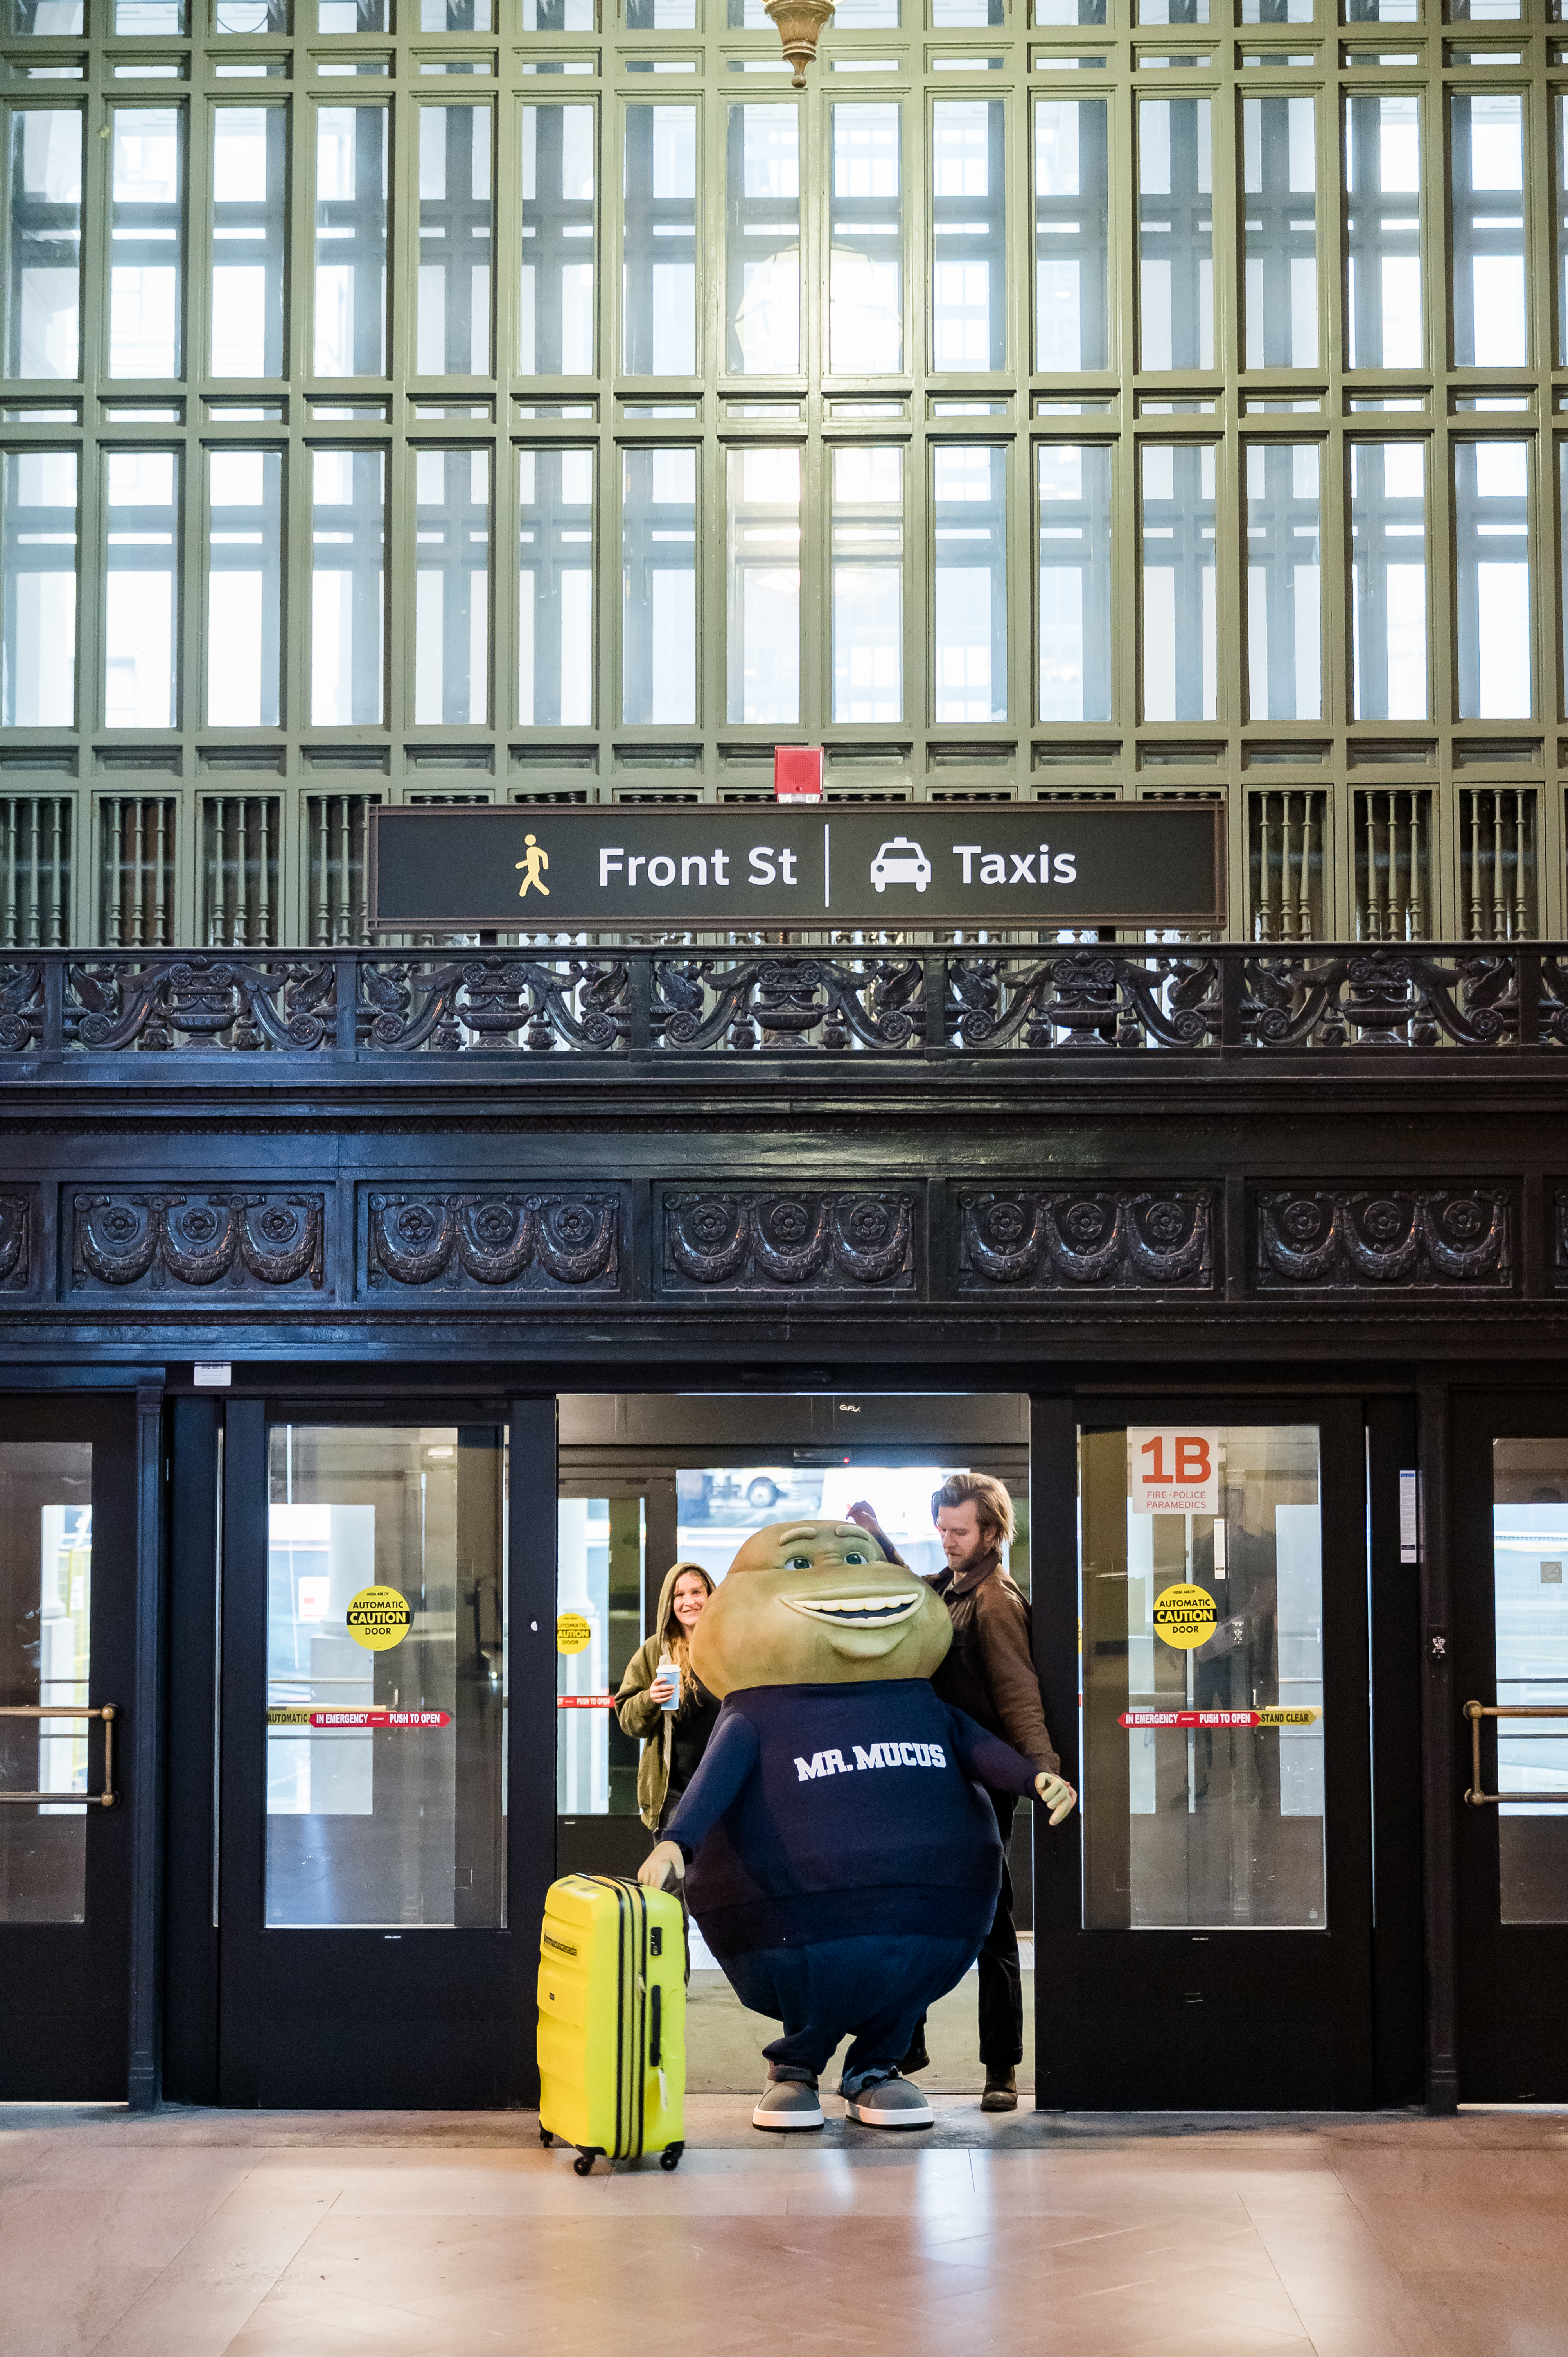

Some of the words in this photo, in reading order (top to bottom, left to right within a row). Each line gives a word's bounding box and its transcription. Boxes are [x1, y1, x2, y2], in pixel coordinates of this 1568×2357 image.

[600, 848, 729, 886] Front
[748, 846, 797, 885] St
[953, 844, 1076, 884] Taxis
[1141, 1436, 1211, 1483] 1B
[1159, 1599, 1210, 1607] AUTOMATIC
[350, 1612, 406, 1624] CAUTION
[1157, 1610, 1213, 1622] CAUTION
[557, 1630, 589, 1638] AUTION
[268, 1713, 307, 1723] AUTOMATIC
[316, 1714, 324, 1724] IN
[326, 1714, 368, 1724] EMERGENCY
[389, 1713, 408, 1723] PUSH
[410, 1713, 420, 1723] TO
[421, 1713, 440, 1723] OPEN
[1126, 1714, 1134, 1724] IN
[1135, 1714, 1178, 1724] EMERGENCY
[1199, 1713, 1219, 1723] PUSH
[1220, 1713, 1230, 1723] TO
[1232, 1713, 1251, 1723] OPEN
[1261, 1713, 1284, 1723] STAND
[1286, 1713, 1309, 1723] CLEAR
[794, 1749, 853, 1782] MR.
[852, 1743, 947, 1770] MUCUS
